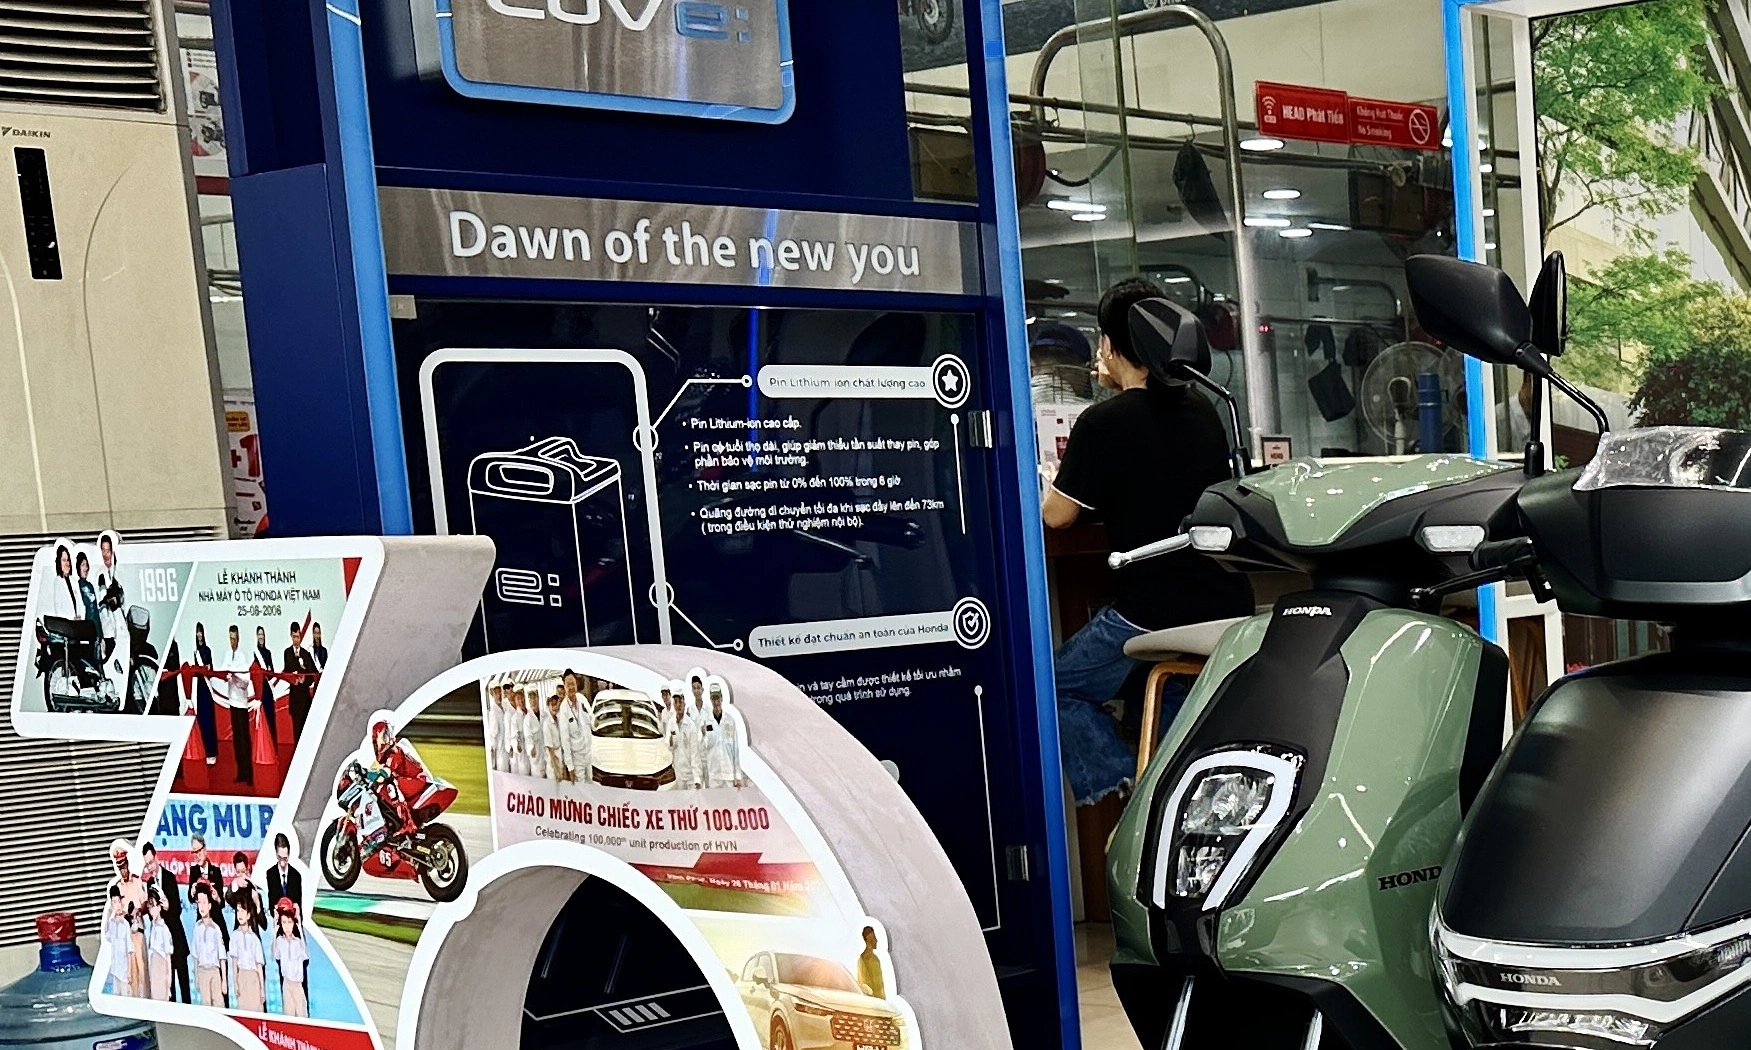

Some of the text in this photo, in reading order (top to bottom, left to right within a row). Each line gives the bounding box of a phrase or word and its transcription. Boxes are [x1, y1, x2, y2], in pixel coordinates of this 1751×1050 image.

[1282, 105, 1305, 120] HEAD
[12, 129, 51, 138] DAIKIN
[448, 210, 920, 284] Dawn of the new you
[769, 377, 787, 387] Pin
[790, 377, 831, 387] Lithium
[834, 377, 850, 387] ion
[908, 380, 926, 388] cao
[691, 417, 707, 429] Pin
[763, 419, 781, 428] cao
[693, 441, 709, 452] Pin
[763, 479, 778, 492] pin
[792, 477, 807, 488] 0%
[829, 476, 854, 488] 100%
[231, 571, 263, 584] KHÁNH
[265, 568, 296, 583] THÀNH
[138, 568, 178, 602] 1996
[199, 589, 215, 602] NHÀ
[216, 589, 232, 601] MÁY
[254, 589, 282, 601] HONDA
[302, 588, 321, 600] NAM
[1282, 606, 1332, 617] HONDA
[858, 630, 871, 639] an
[917, 622, 949, 634] Honda
[507, 790, 770, 831] CHÀO MỪNG CHIẾC XE THỨ 100.000
[535, 825, 586, 844] Celebrating
[629, 838, 646, 848] unit
[649, 839, 700, 851] production
[703, 840, 713, 851] of
[715, 841, 738, 851] HVN
[1378, 865, 1442, 891] HOND
[1500, 973, 1562, 986] HONDA
